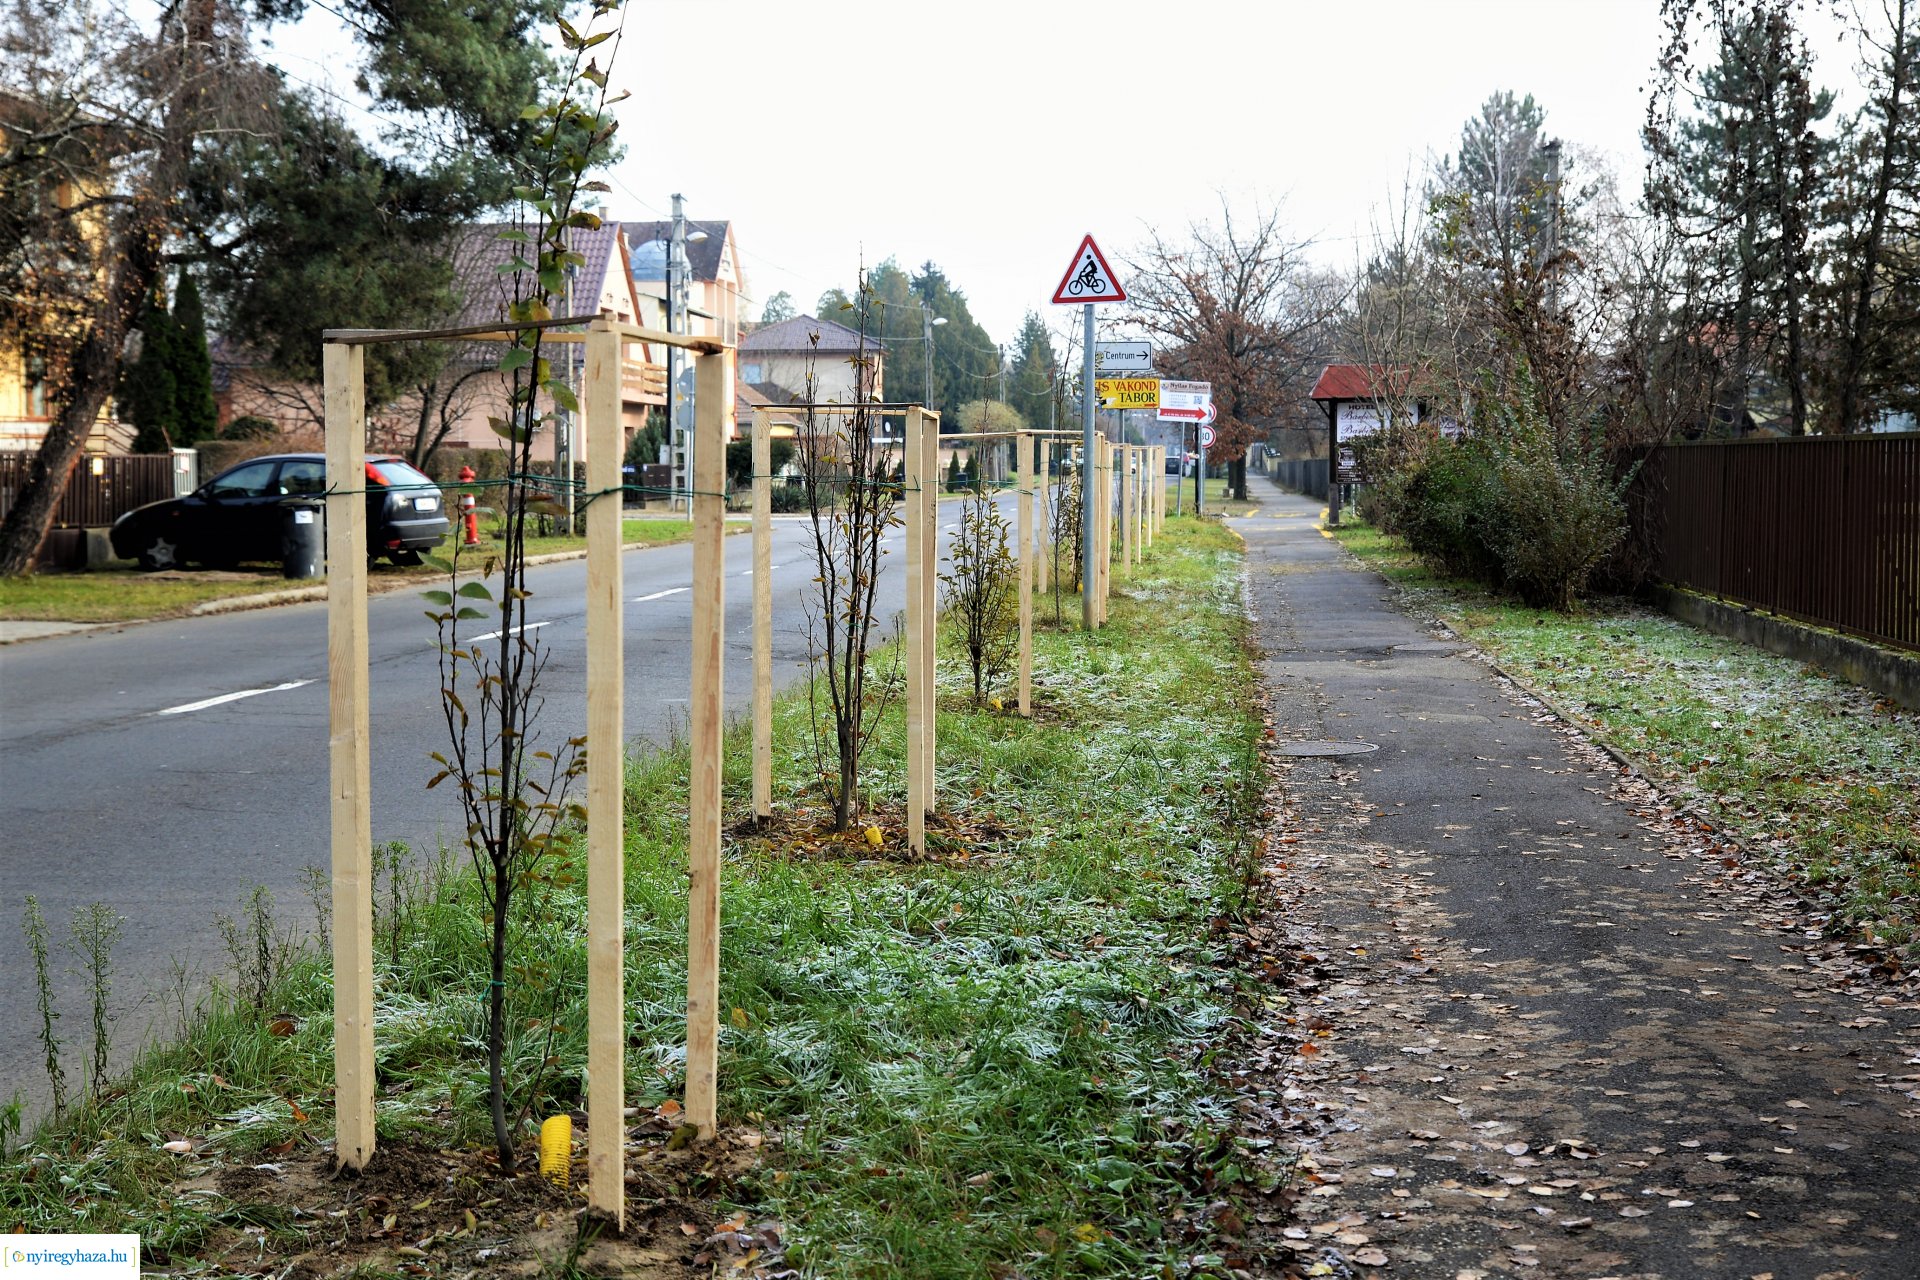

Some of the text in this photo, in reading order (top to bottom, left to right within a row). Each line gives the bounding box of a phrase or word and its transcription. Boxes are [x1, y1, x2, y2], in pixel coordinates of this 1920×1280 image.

[1105, 351, 1135, 360] Centrum
[1095, 381, 1157, 391] IS VAKOND
